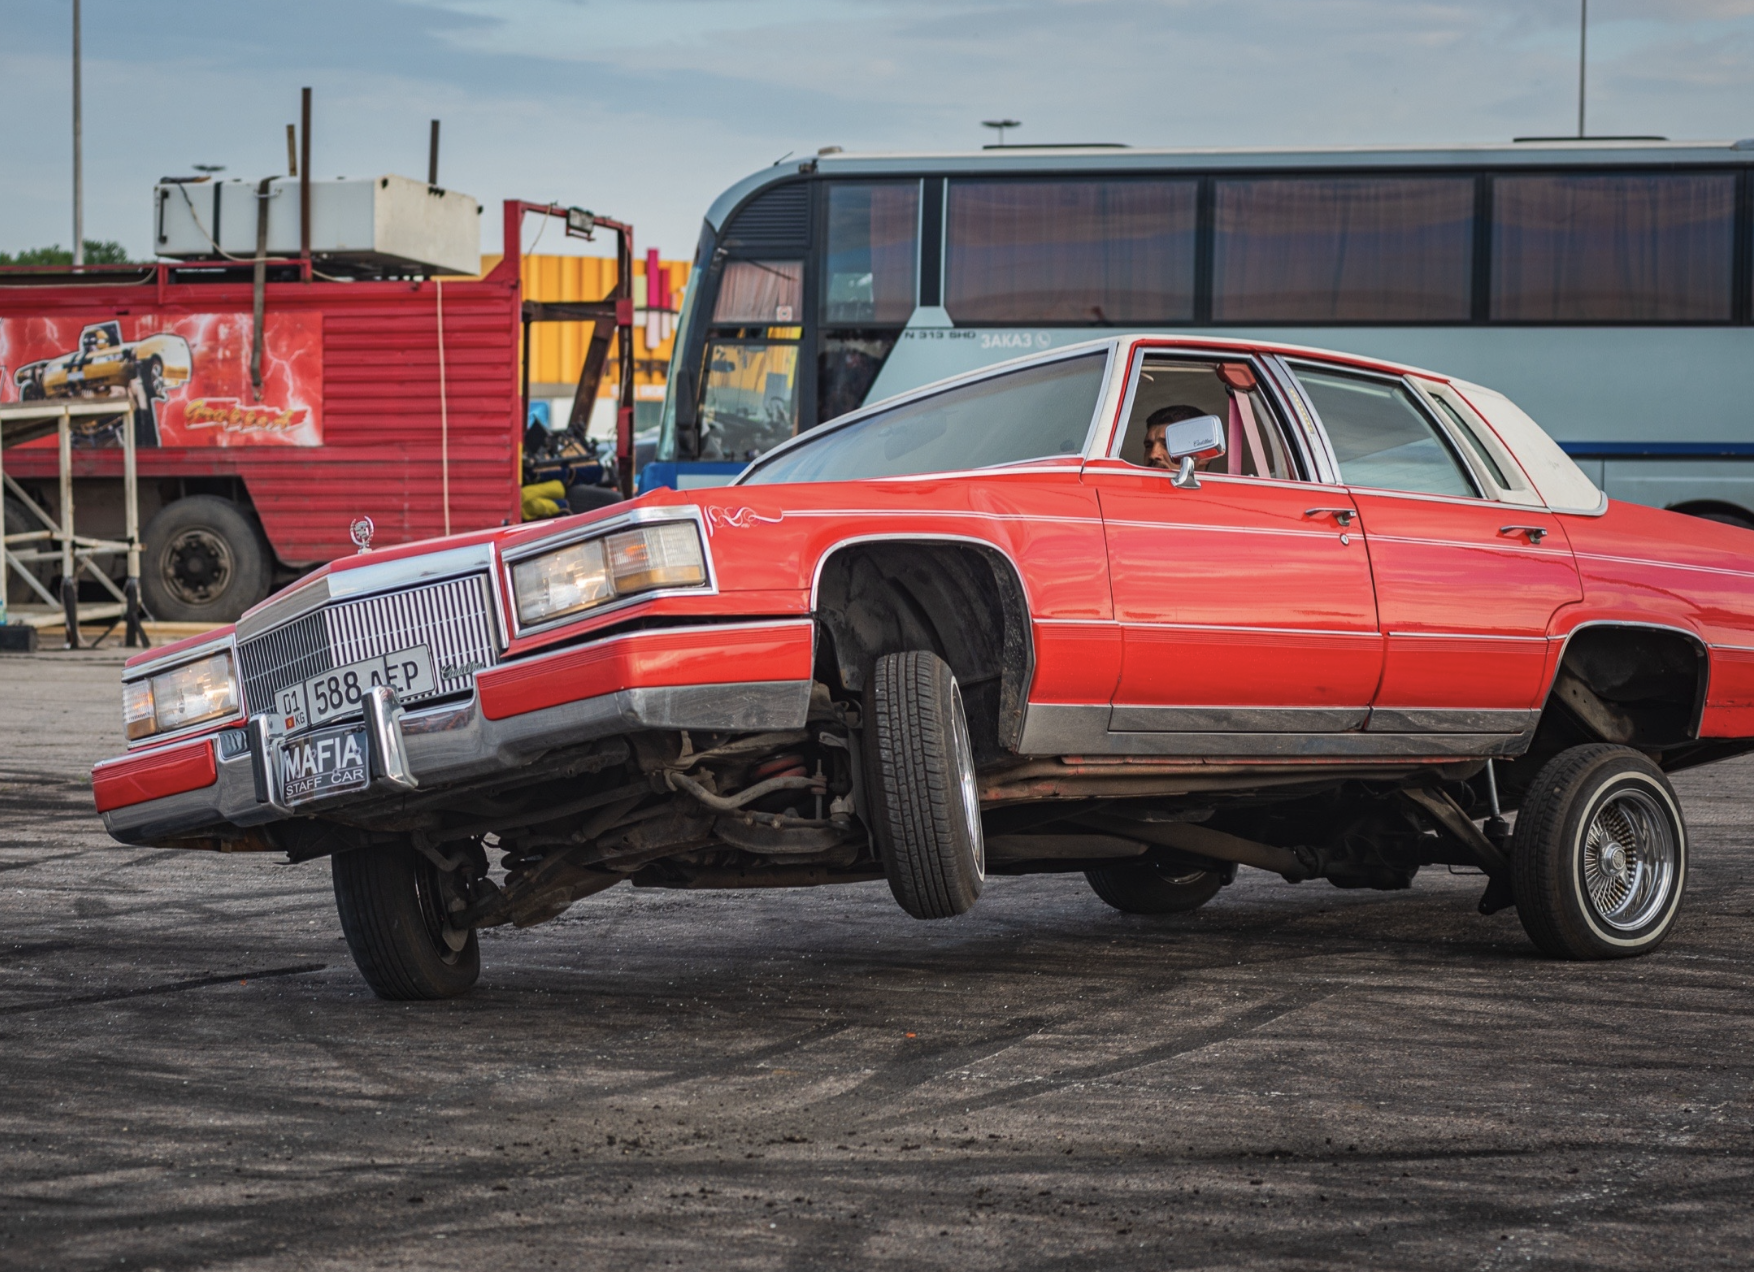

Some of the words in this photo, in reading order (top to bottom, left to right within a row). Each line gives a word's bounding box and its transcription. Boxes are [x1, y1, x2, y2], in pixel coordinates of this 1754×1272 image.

[904, 331, 915, 339] N
[919, 331, 945, 339] 313
[981, 333, 1033, 349] ЗАКАЗ
[284, 691, 300, 714] 01
[314, 671, 362, 716] 588
[294, 712, 306, 727] KG
[284, 734, 363, 782] MAFIA
[286, 776, 323, 796] STAFF
[331, 769, 364, 783] CAR
